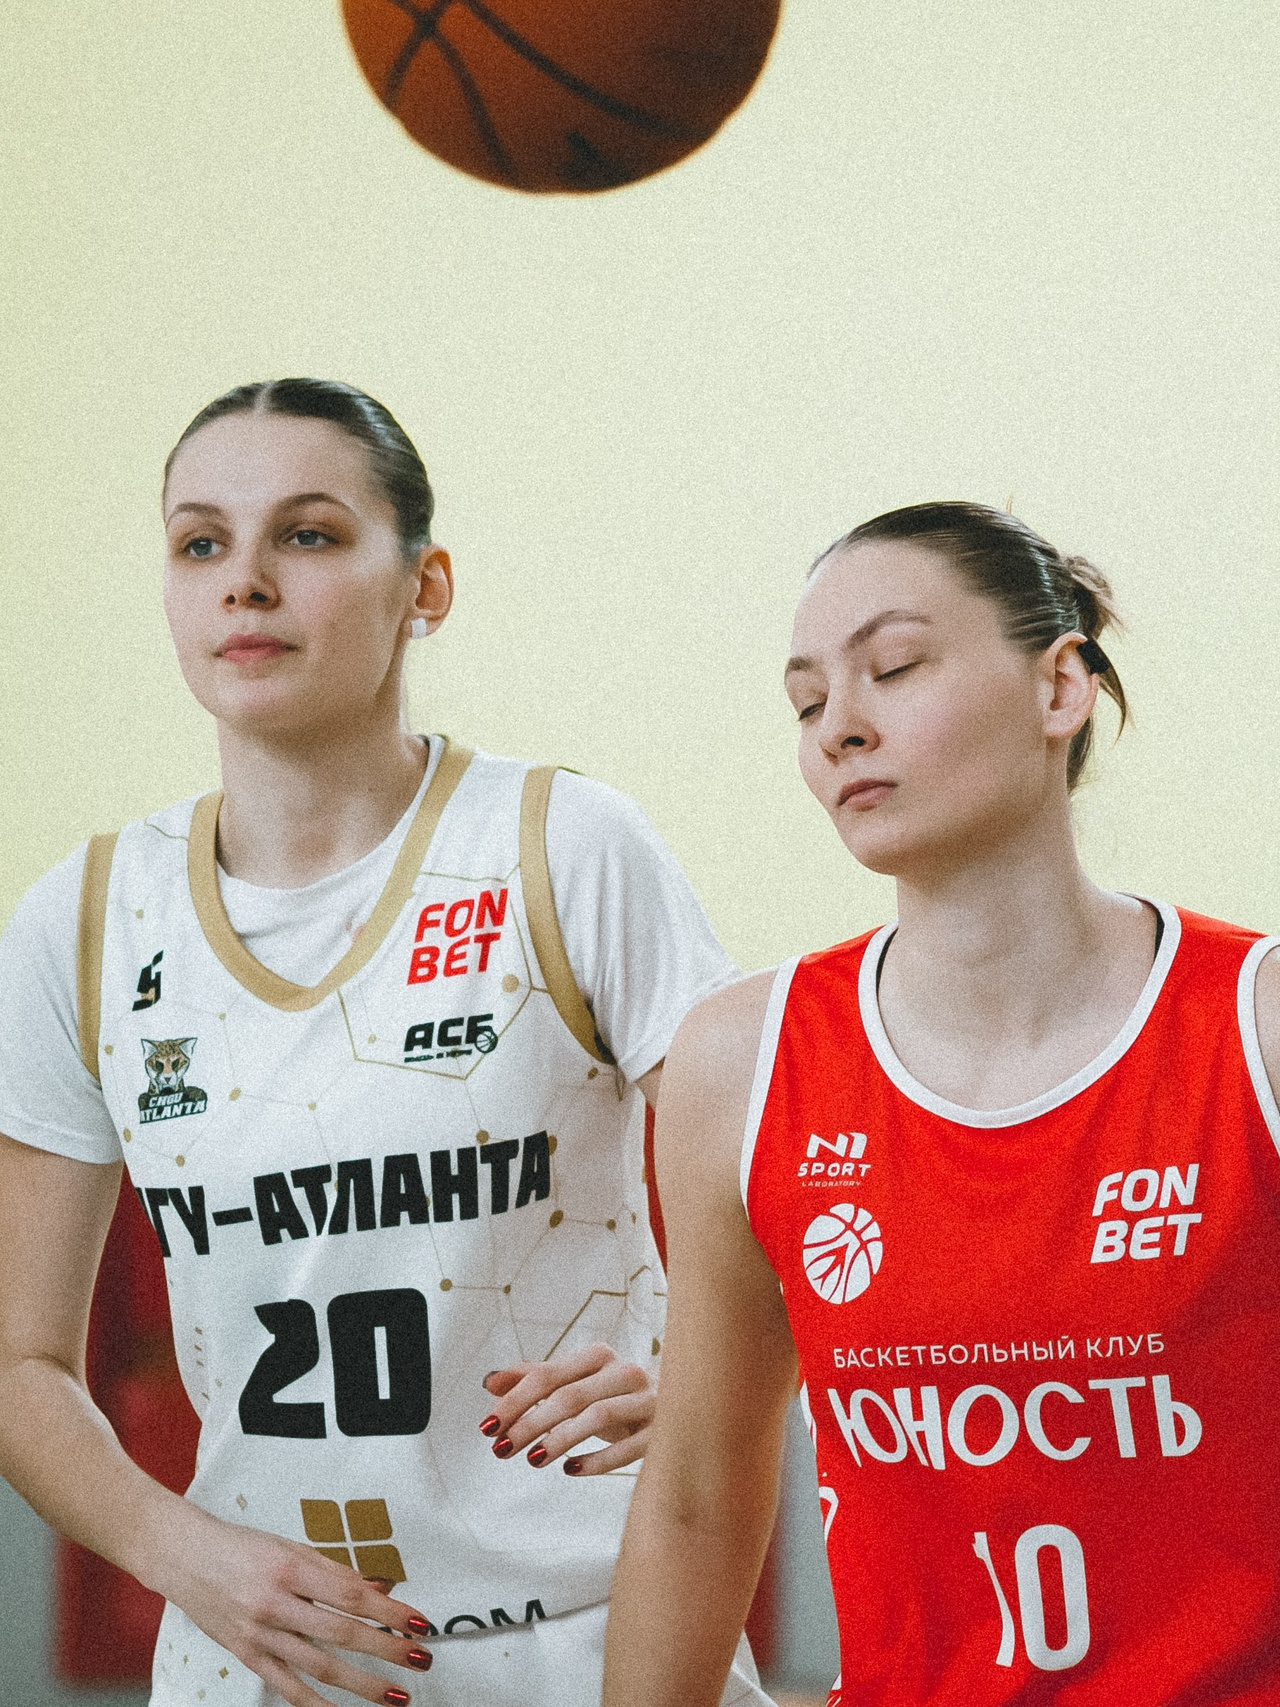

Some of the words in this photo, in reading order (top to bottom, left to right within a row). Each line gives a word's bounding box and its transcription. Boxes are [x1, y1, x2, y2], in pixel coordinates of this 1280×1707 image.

[414, 888, 508, 943] FON
[407, 931, 501, 986] BET
[134, 1130, 551, 1258] ГУ-АТЛАНТА
[797, 1162, 871, 1177] SPORT
[1092, 1164, 1199, 1217] FON
[1090, 1213, 1202, 1264] BET
[238, 1287, 432, 1439] 20
[834, 1335, 1075, 1368] БАСКЕТБОЛЬНЫЙ
[1086, 1333, 1164, 1358] КЛУБ
[827, 1374, 1202, 1470] ЮНОСТЬ
[972, 1524, 1090, 1671] 10
